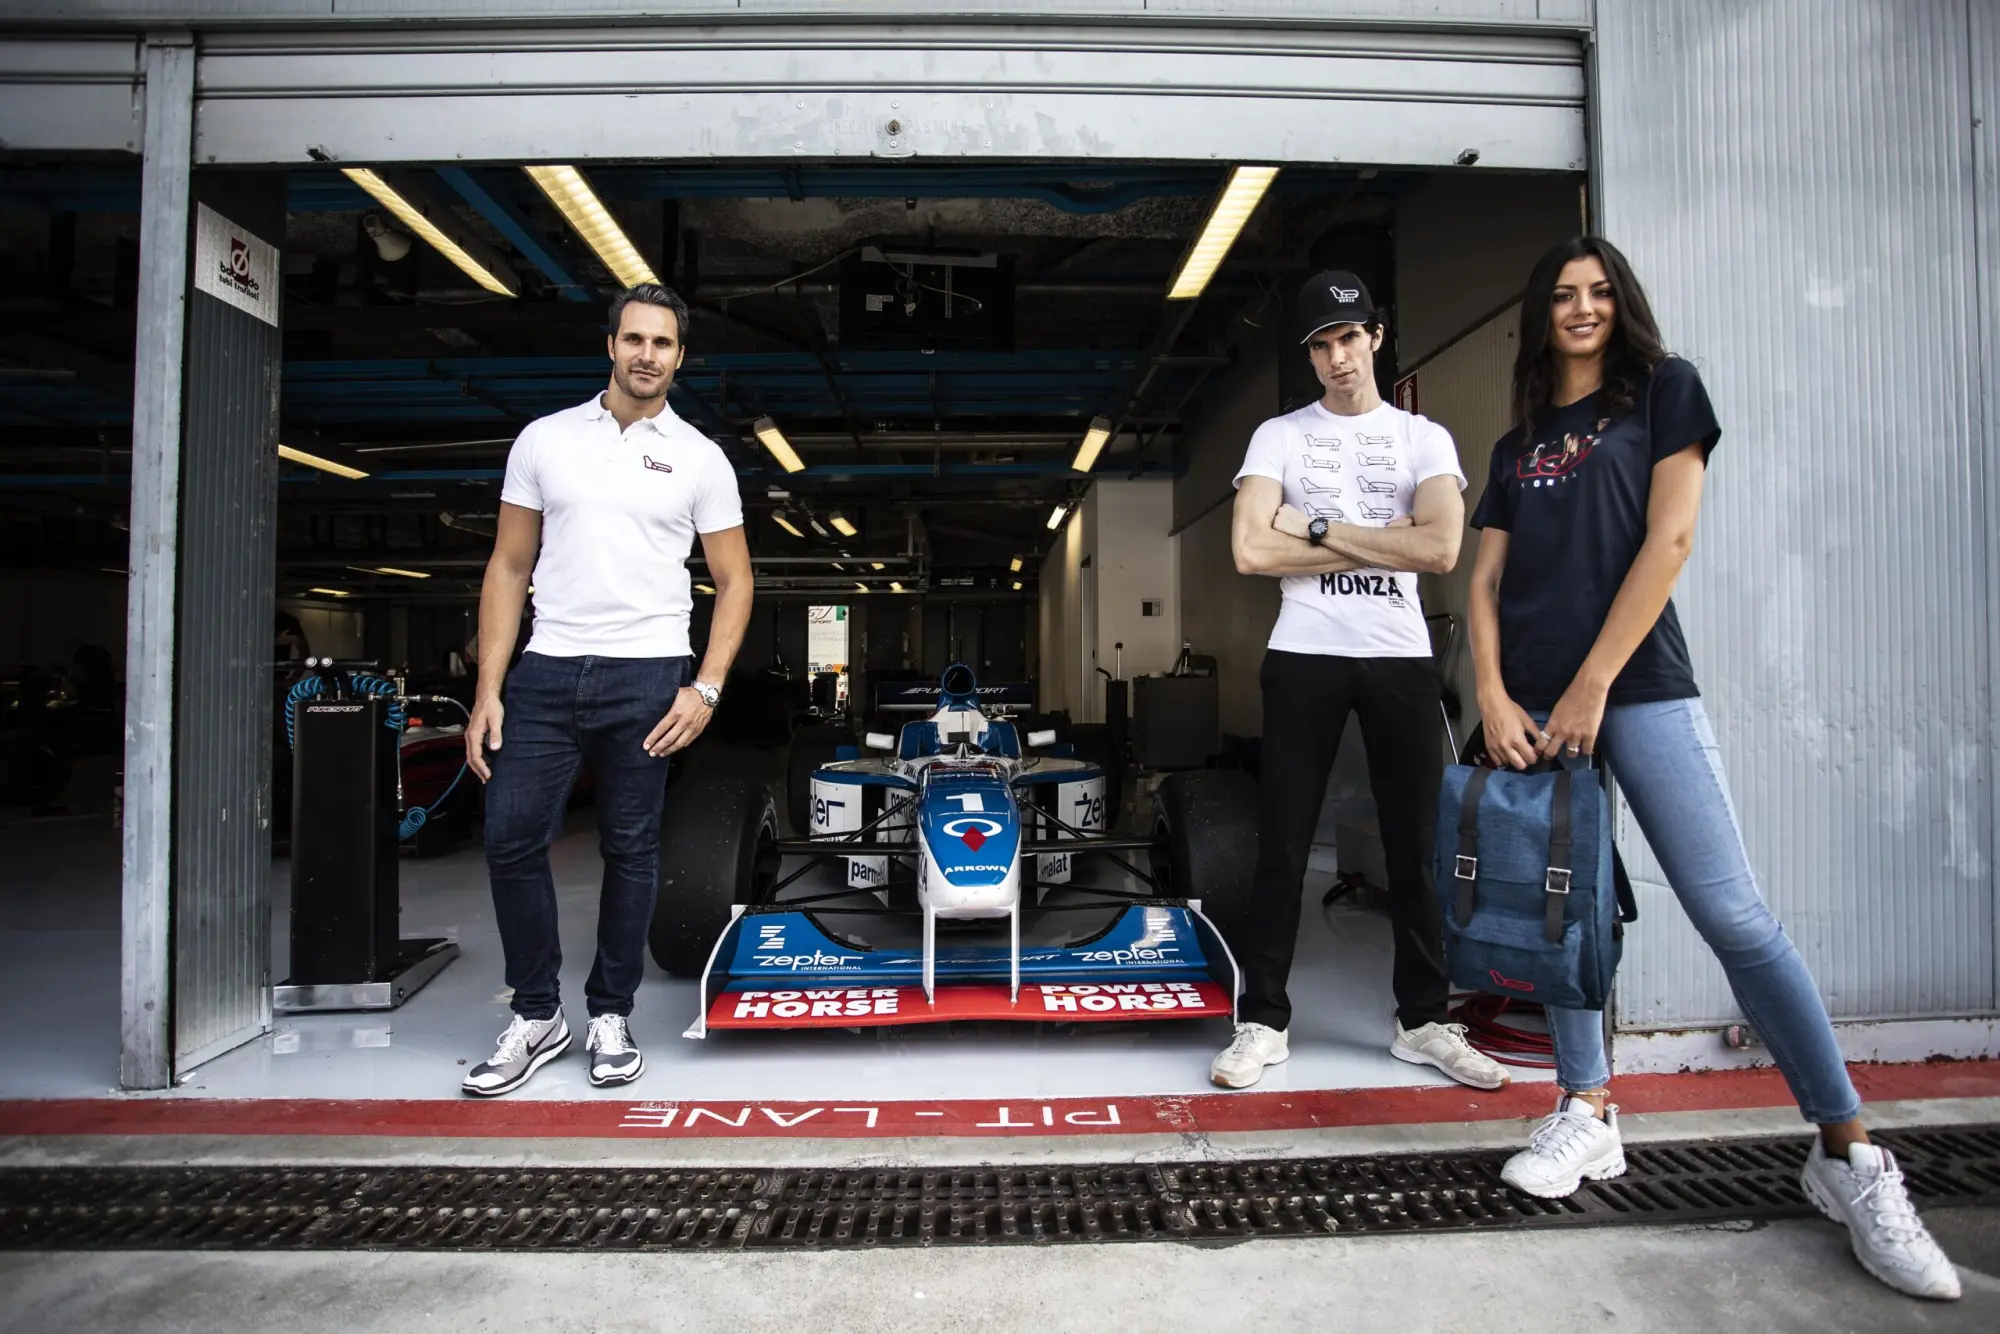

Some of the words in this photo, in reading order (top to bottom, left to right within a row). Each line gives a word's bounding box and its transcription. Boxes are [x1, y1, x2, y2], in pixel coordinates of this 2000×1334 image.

[1320, 572, 1403, 598] MONZA
[946, 793, 984, 811] 1
[945, 865, 1008, 876] ARROWS
[753, 949, 863, 971] zepter
[1072, 944, 1179, 965] zepter
[740, 988, 899, 1001] POWER
[1040, 983, 1196, 994] POWER
[733, 998, 898, 1018] HORSE
[1043, 993, 1206, 1011] HORSE
[619, 1107, 880, 1129] LANE
[976, 1104, 1121, 1128] PIT
